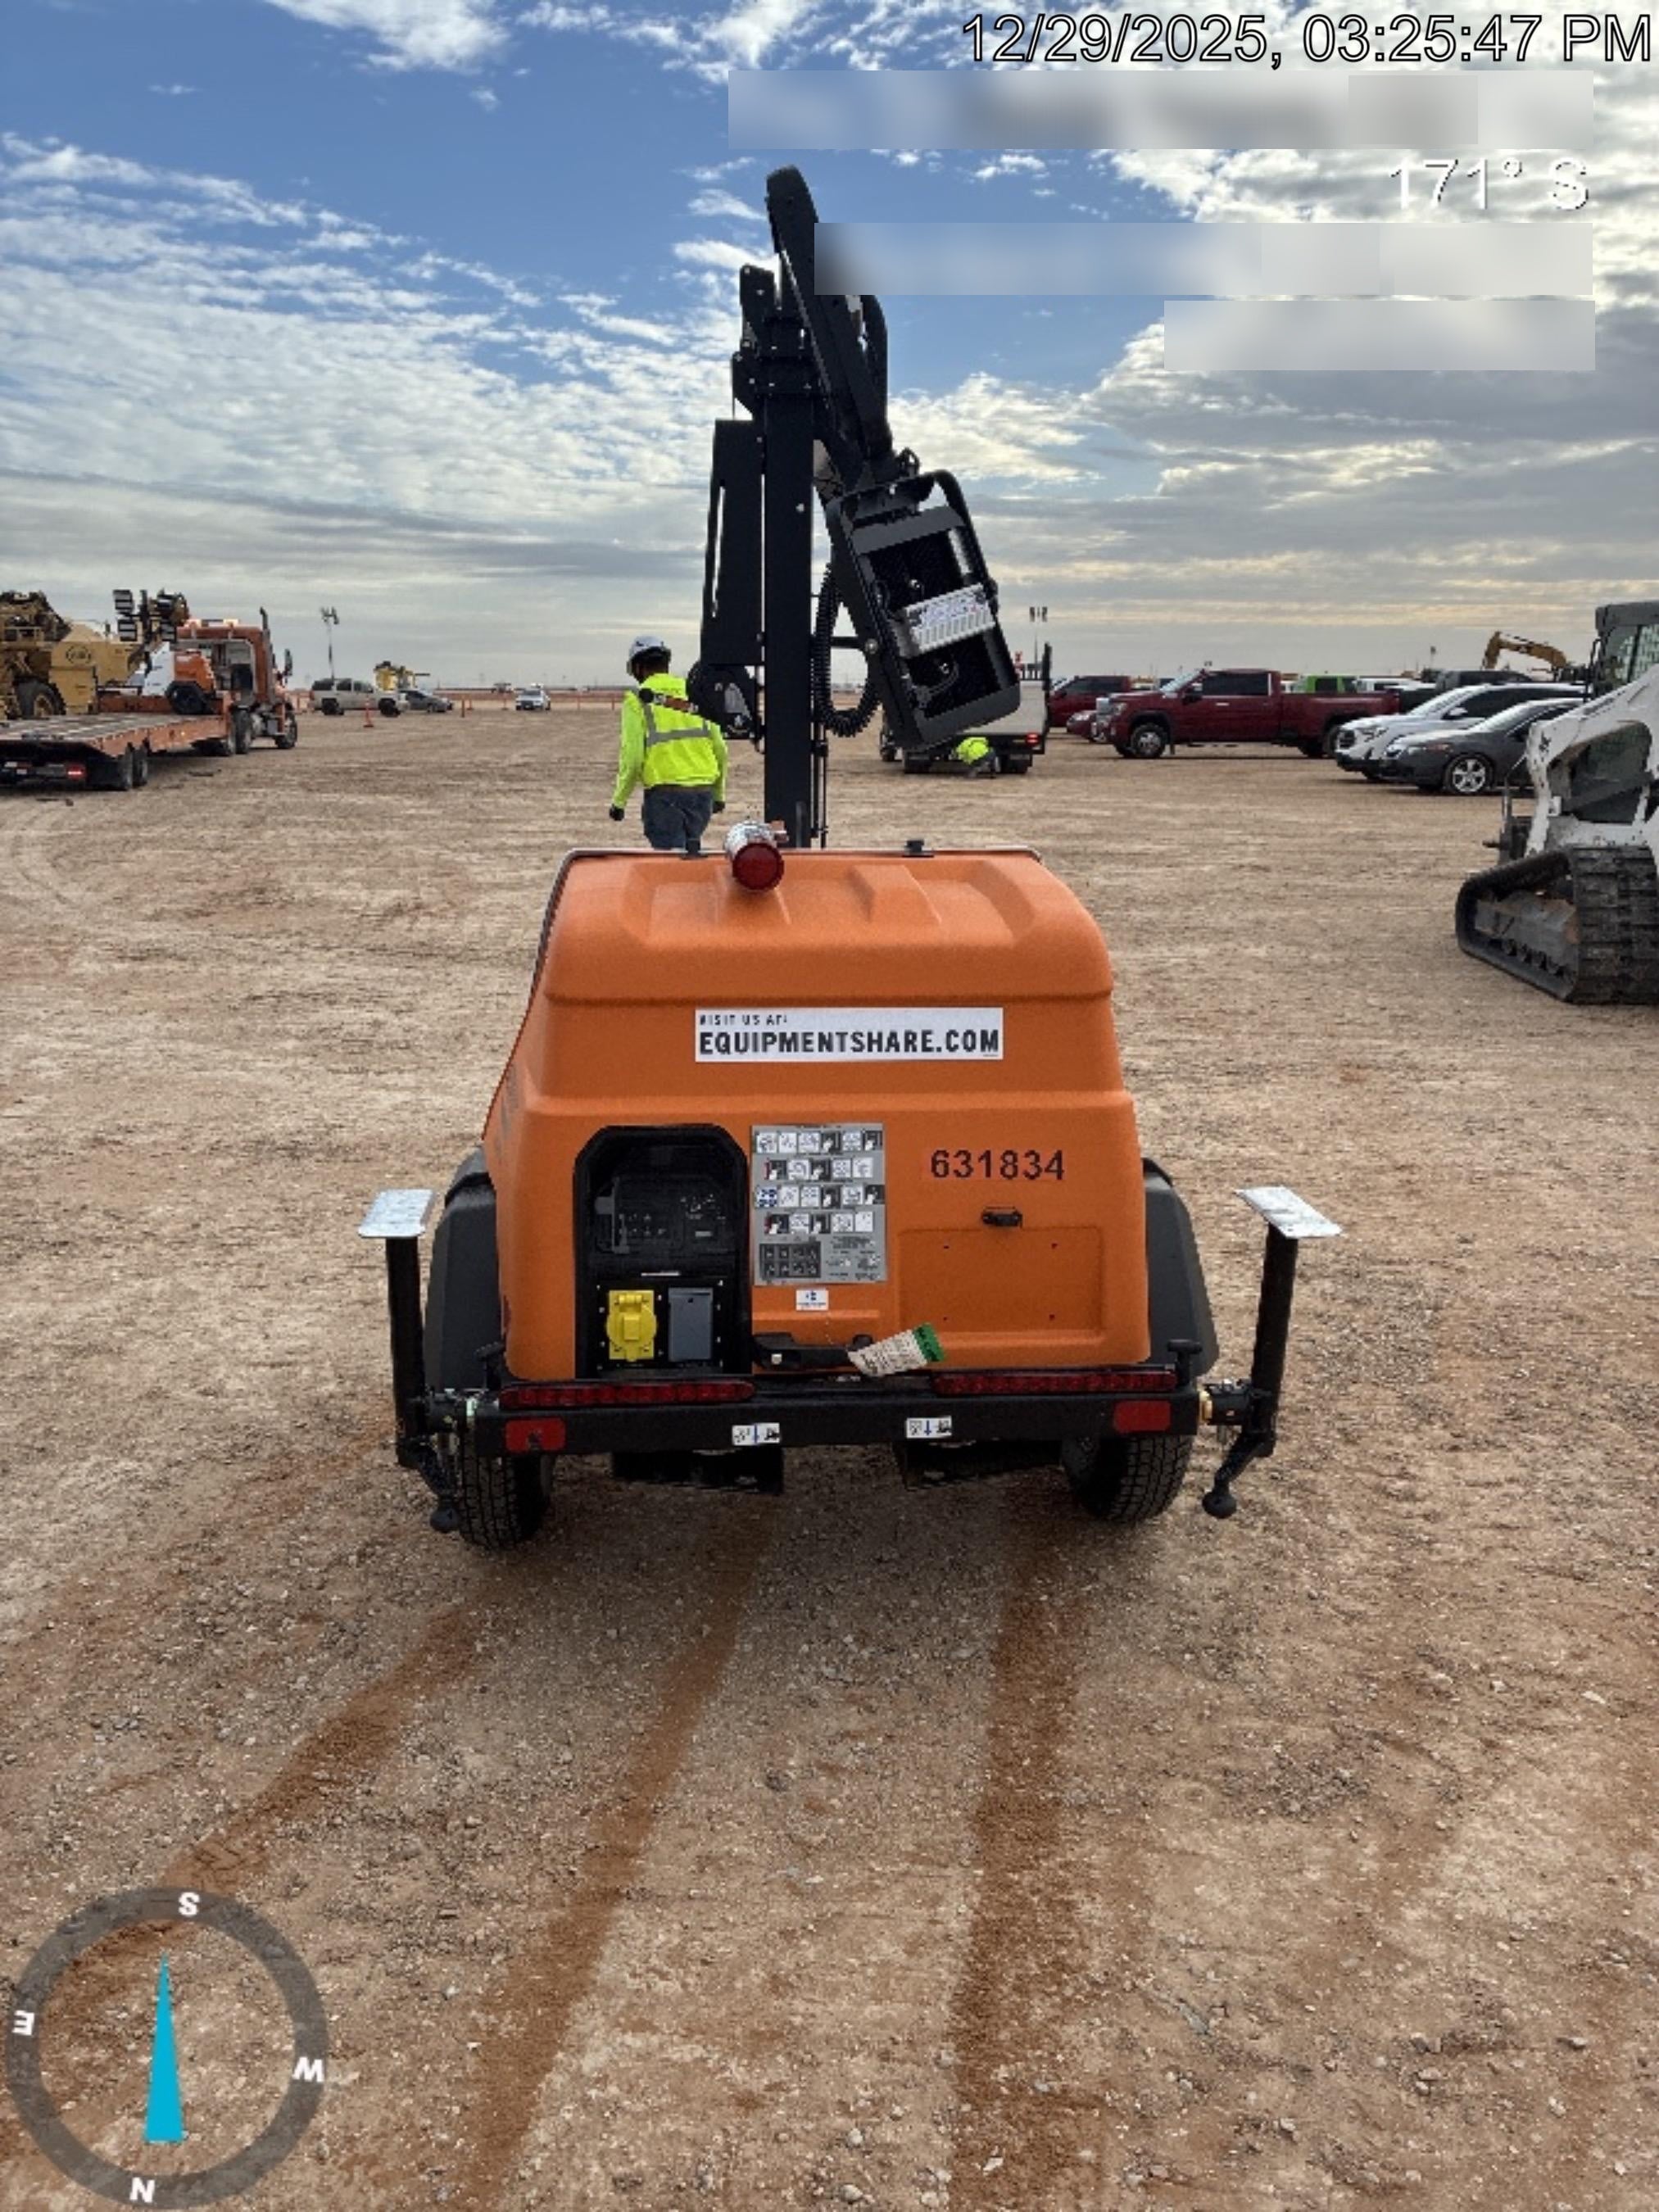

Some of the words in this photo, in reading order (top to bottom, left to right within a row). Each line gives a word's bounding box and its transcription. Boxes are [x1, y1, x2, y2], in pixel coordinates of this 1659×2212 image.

[742, 1014, 760, 1026] US
[700, 1029, 999, 1055] EQUIPMENTSHARE.COM
[931, 1149, 1064, 1181] 631834
